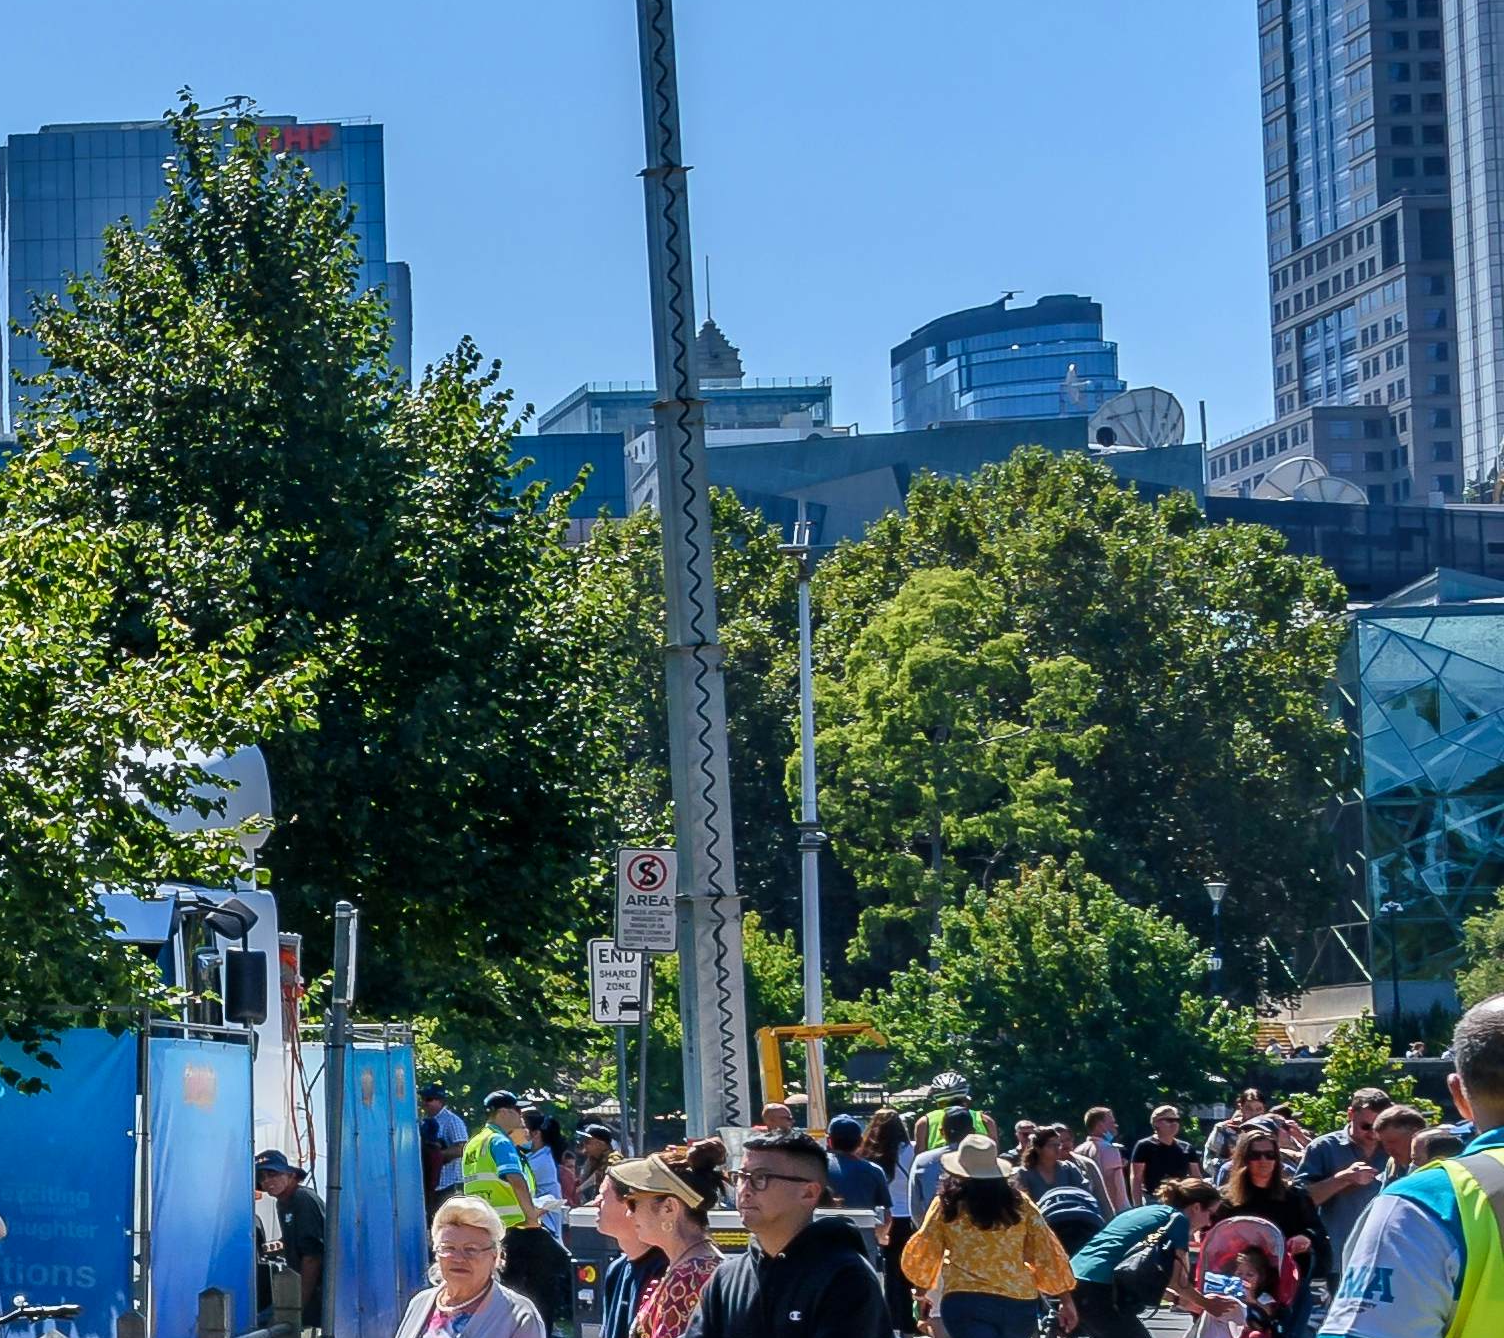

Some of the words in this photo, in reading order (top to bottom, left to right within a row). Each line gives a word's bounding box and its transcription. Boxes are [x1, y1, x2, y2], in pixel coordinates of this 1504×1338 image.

[625, 894, 670, 907] AREA
[599, 949, 636, 964] END
[599, 969, 637, 979] SHARED
[605, 982, 632, 991] ZONE
